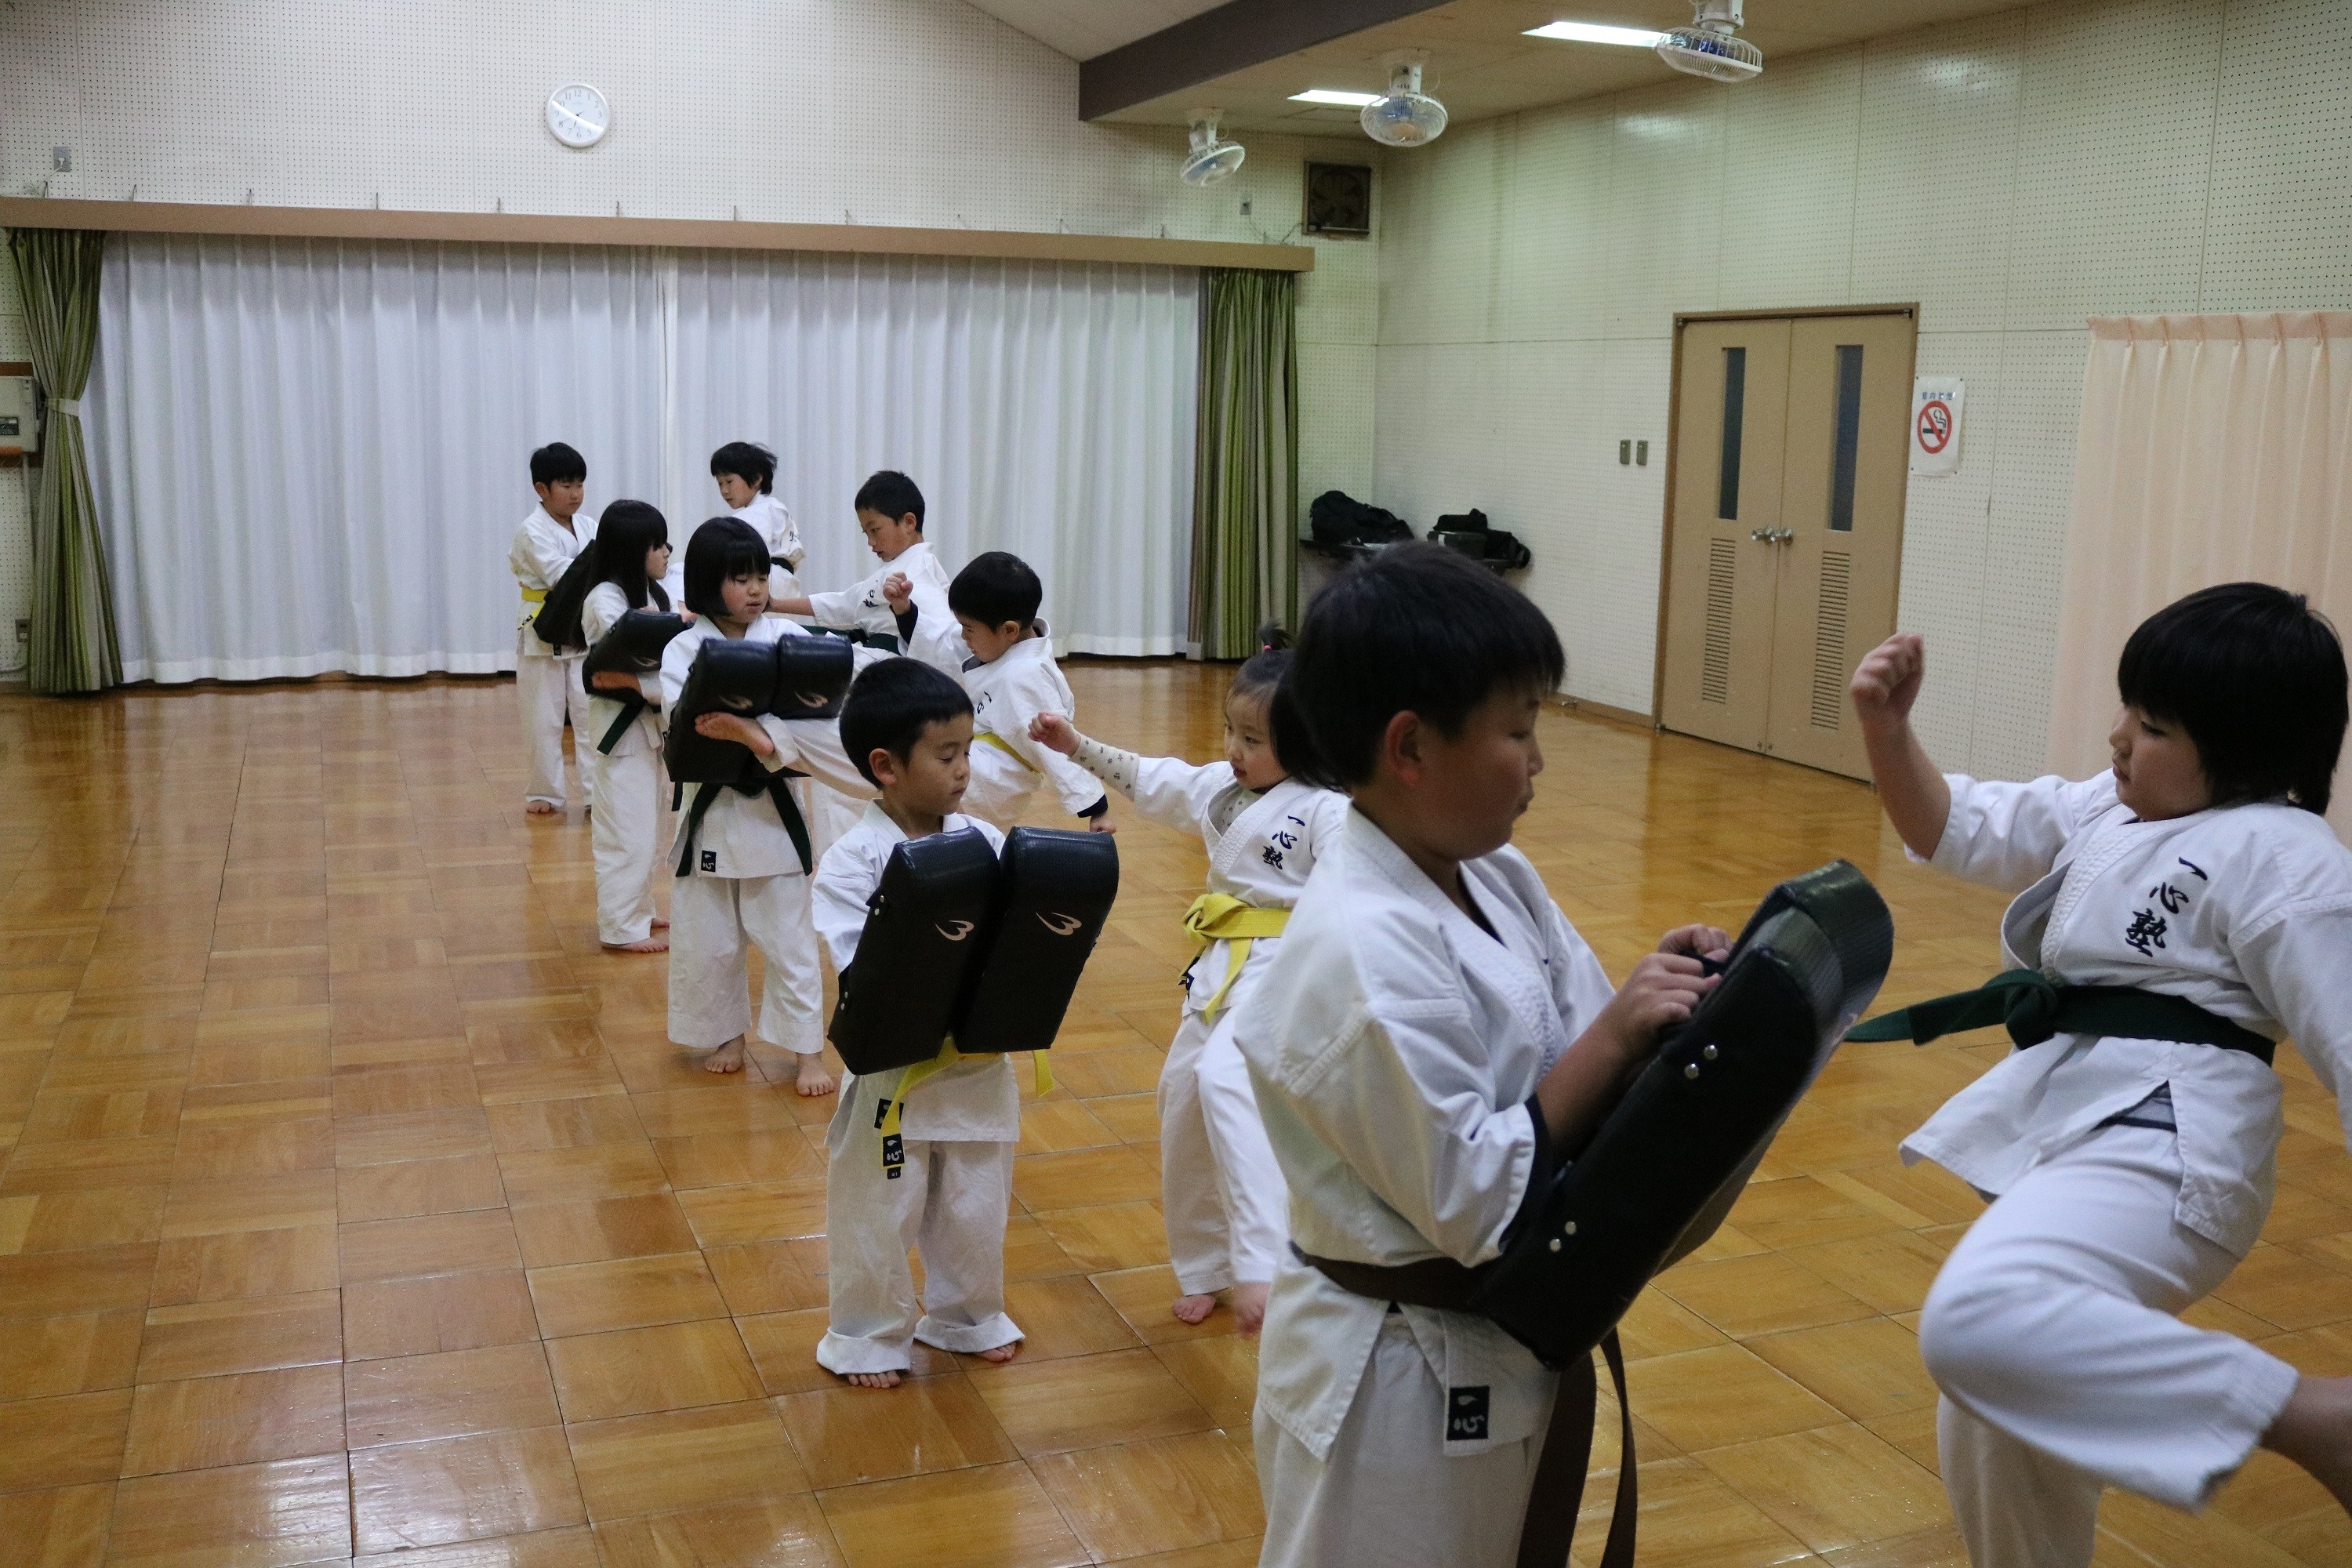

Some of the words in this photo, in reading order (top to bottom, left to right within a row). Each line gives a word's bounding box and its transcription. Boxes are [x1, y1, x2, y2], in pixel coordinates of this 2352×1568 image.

[567, 127, 572, 136] 7
[576, 129, 582, 138] 6
[2125, 856, 2208, 957] 一心塾
